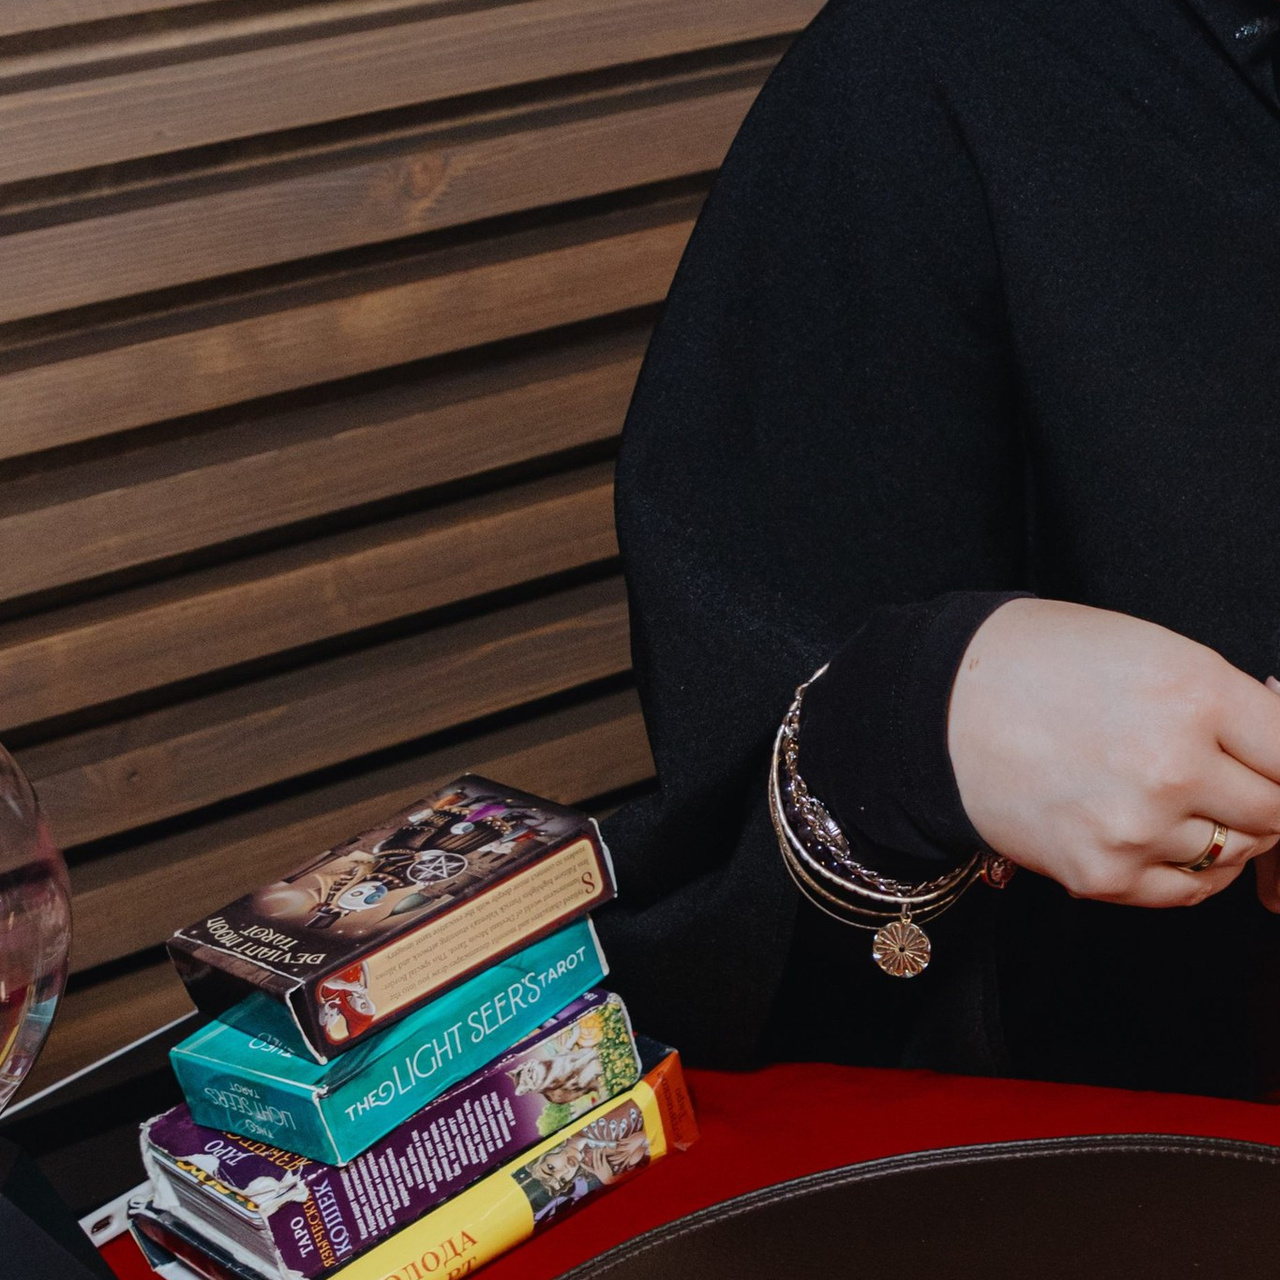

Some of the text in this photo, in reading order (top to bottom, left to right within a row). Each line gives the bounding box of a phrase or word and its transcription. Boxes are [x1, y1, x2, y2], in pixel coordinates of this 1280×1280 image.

[206, 916, 327, 965] DEVIANT MOON
[239, 924, 299, 951] TAROT
[345, 946, 586, 1122] THE LIGHT SEER'S TAROT
[229, 1081, 261, 1099] TAROT
[204, 1140, 251, 1167] ТАРО
[290, 1216, 314, 1258] ТАРО
[313, 1178, 353, 1257] КОШЕК
